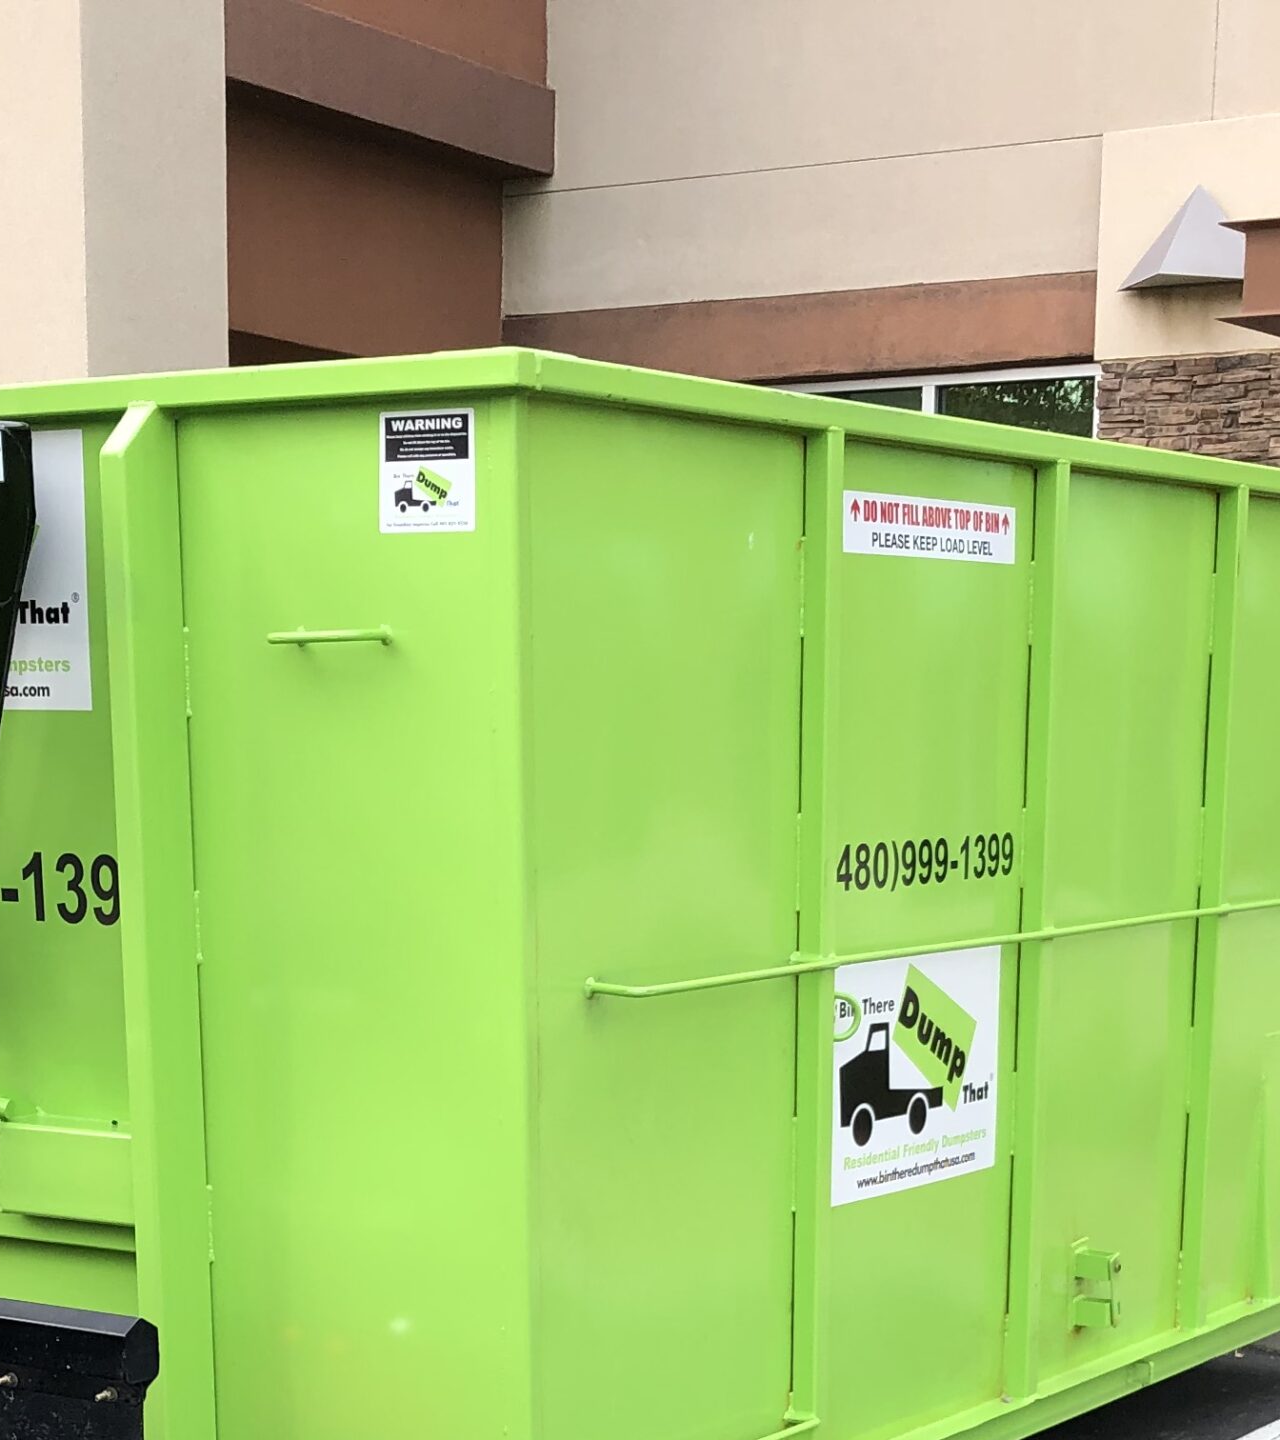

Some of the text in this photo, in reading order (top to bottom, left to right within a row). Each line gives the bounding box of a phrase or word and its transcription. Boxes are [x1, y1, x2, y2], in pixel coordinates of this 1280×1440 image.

[390, 417, 463, 432] WARNING
[415, 471, 448, 500] Dump
[863, 500, 1000, 533] DO NOT FILL ABOVE TOP OF BIN
[872, 532, 993, 556] PLEASE KEEP LOAD LEVEL
[19, 600, 70, 625] That
[836, 832, 1014, 892] 480)999-1399
[862, 997, 895, 1016] There
[898, 985, 967, 1083] Dump
[962, 1081, 989, 1105] That
[843, 1127, 988, 1171] Residential Friendly Dumpsters
[856, 1151, 976, 1189] www.bintheredumpthatusa.com
